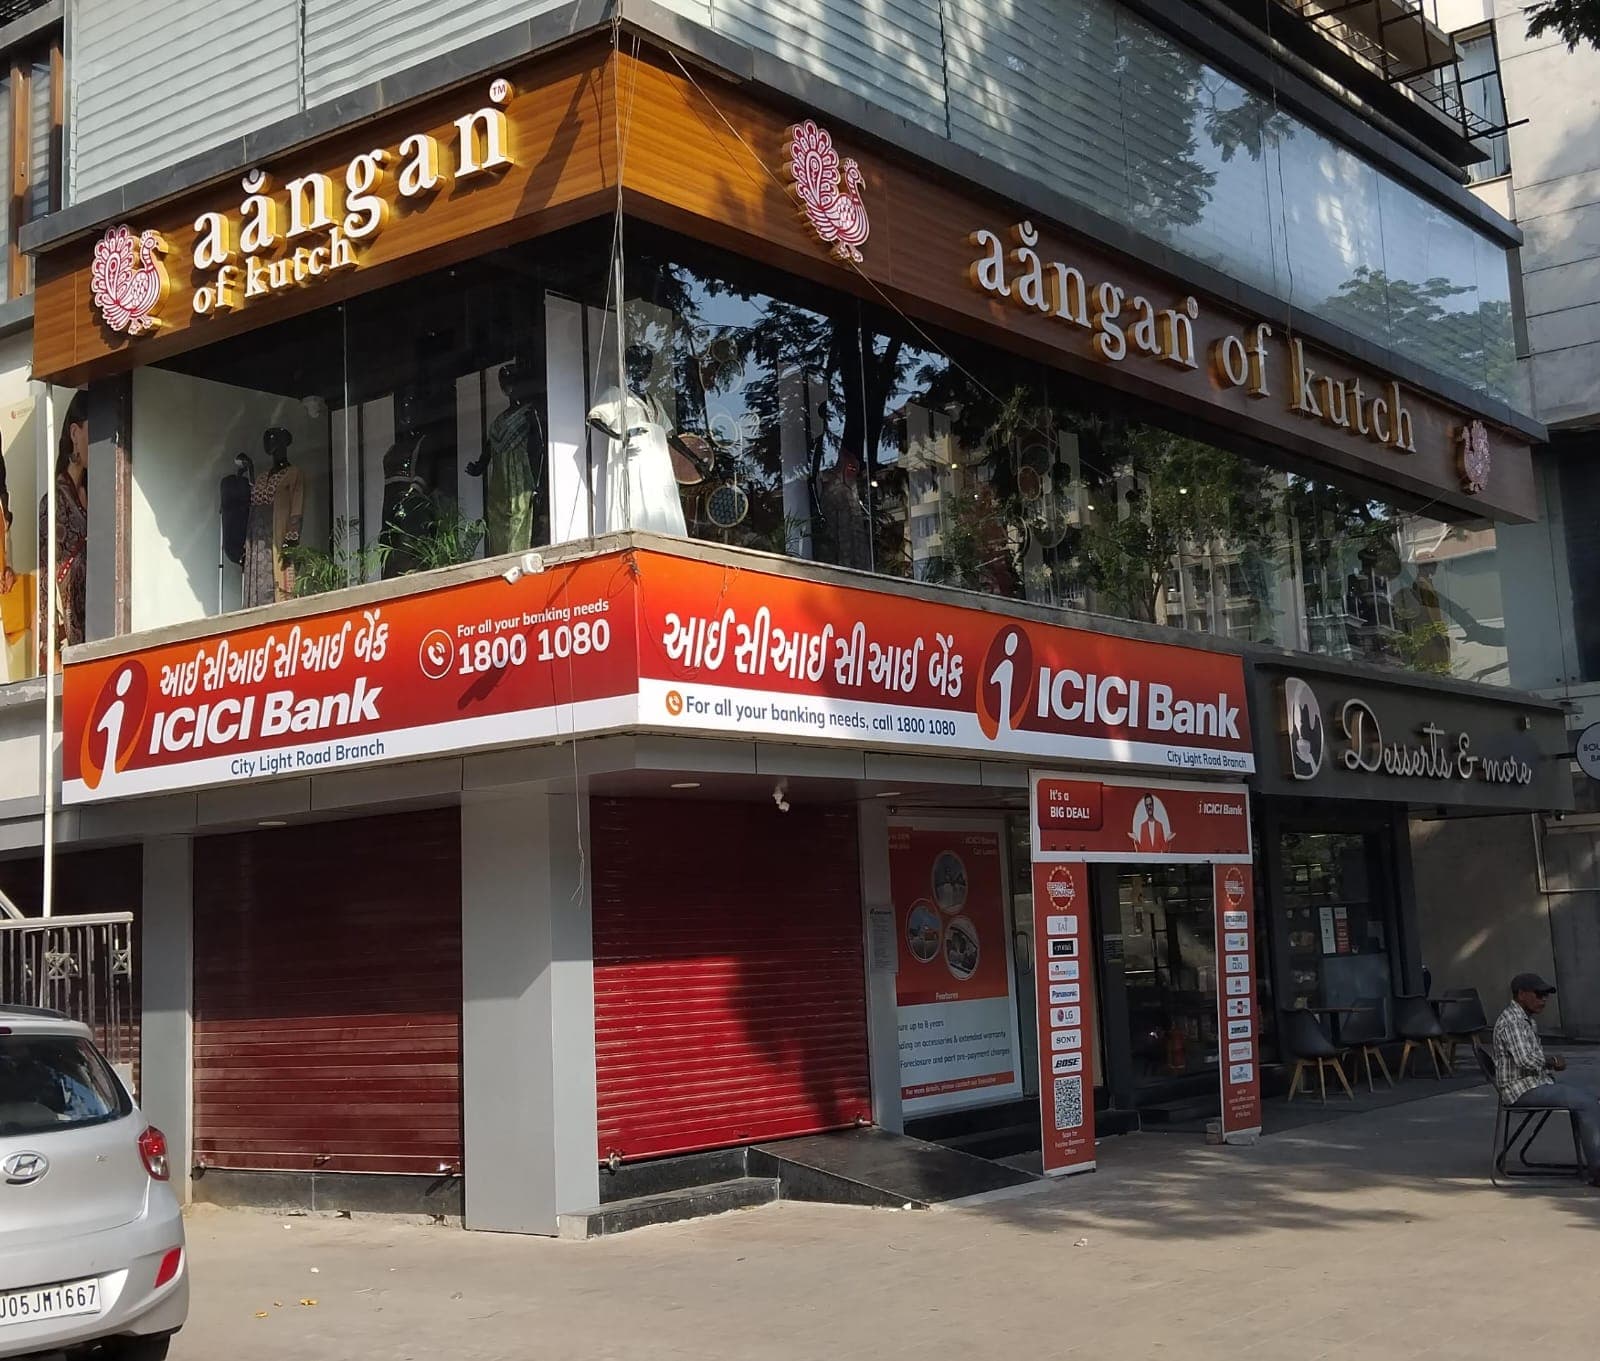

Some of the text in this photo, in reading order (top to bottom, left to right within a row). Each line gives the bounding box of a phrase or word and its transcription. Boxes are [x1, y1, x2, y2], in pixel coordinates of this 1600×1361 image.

[193, 227, 356, 313] of kutch
[1220, 323, 1272, 397] of
[1295, 338, 1417, 453] kutch
[457, 598, 609, 638] For all your banking needs
[459, 619, 610, 674] 1800 1080
[1038, 666, 1240, 740] ICICI Bank
[149, 677, 383, 754] ICICI Bank
[686, 695, 956, 736] For all your banking needs, call 1800 1080
[1342, 698, 1531, 784] Desserts & more
[231, 738, 385, 776] City Light Road Branch
[1167, 750, 1247, 768] City Light Road Branch
[1050, 789, 1069, 801] It's a
[1050, 807, 1090, 819] BIG DEAL!
[1203, 803, 1222, 814] ICICI
[1223, 804, 1243, 815] Bank
[935, 992, 958, 1000] Features
[1052, 990, 1077, 998] Panasonic
[1065, 1010, 1073, 1019] LG
[929, 1020, 944, 1030] years
[922, 1038, 953, 1047] accessories
[959, 1033, 982, 1042] extended
[1056, 1036, 1077, 1044] SONY
[900, 1057, 931, 1069] Foreclosure
[933, 1056, 943, 1064] and
[1055, 1058, 1080, 1068] BOSE
